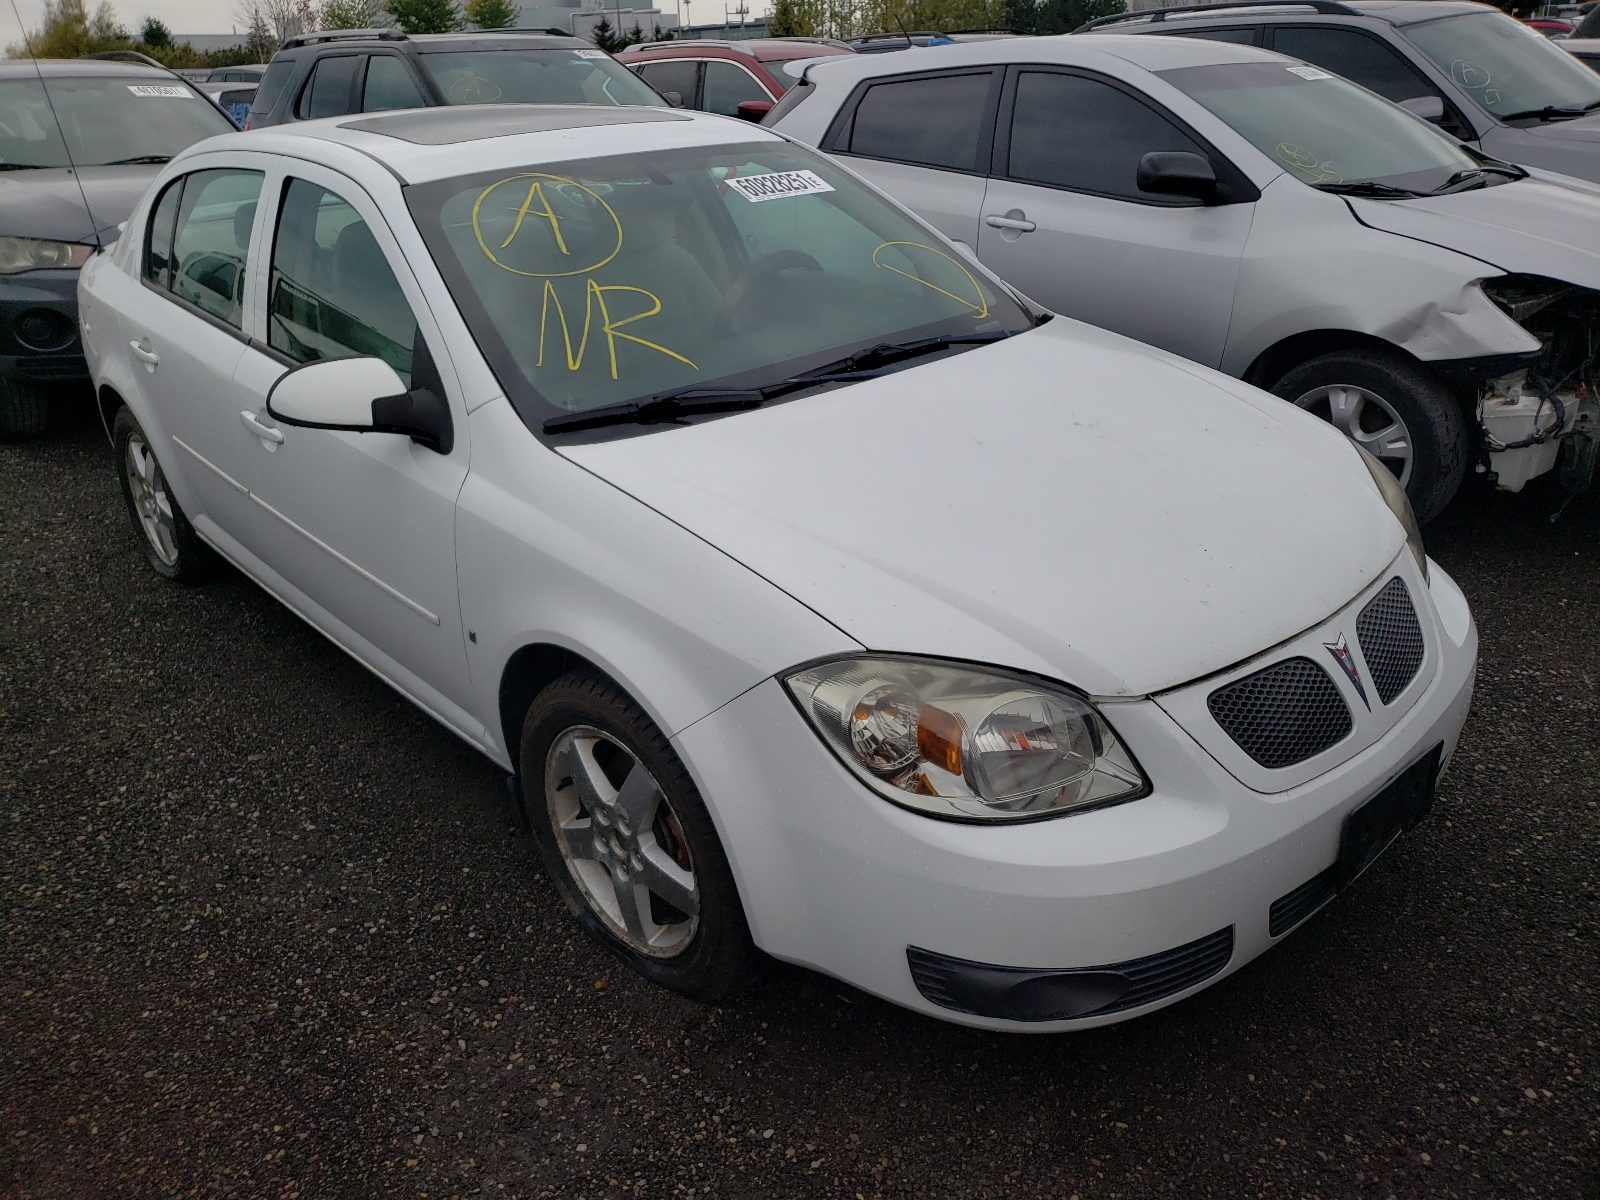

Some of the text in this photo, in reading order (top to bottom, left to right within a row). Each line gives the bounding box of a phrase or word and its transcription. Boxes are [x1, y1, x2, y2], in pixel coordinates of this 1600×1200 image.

[500, 181, 571, 256] A
[736, 172, 817, 197] 60828251
[535, 278, 700, 380] NR
